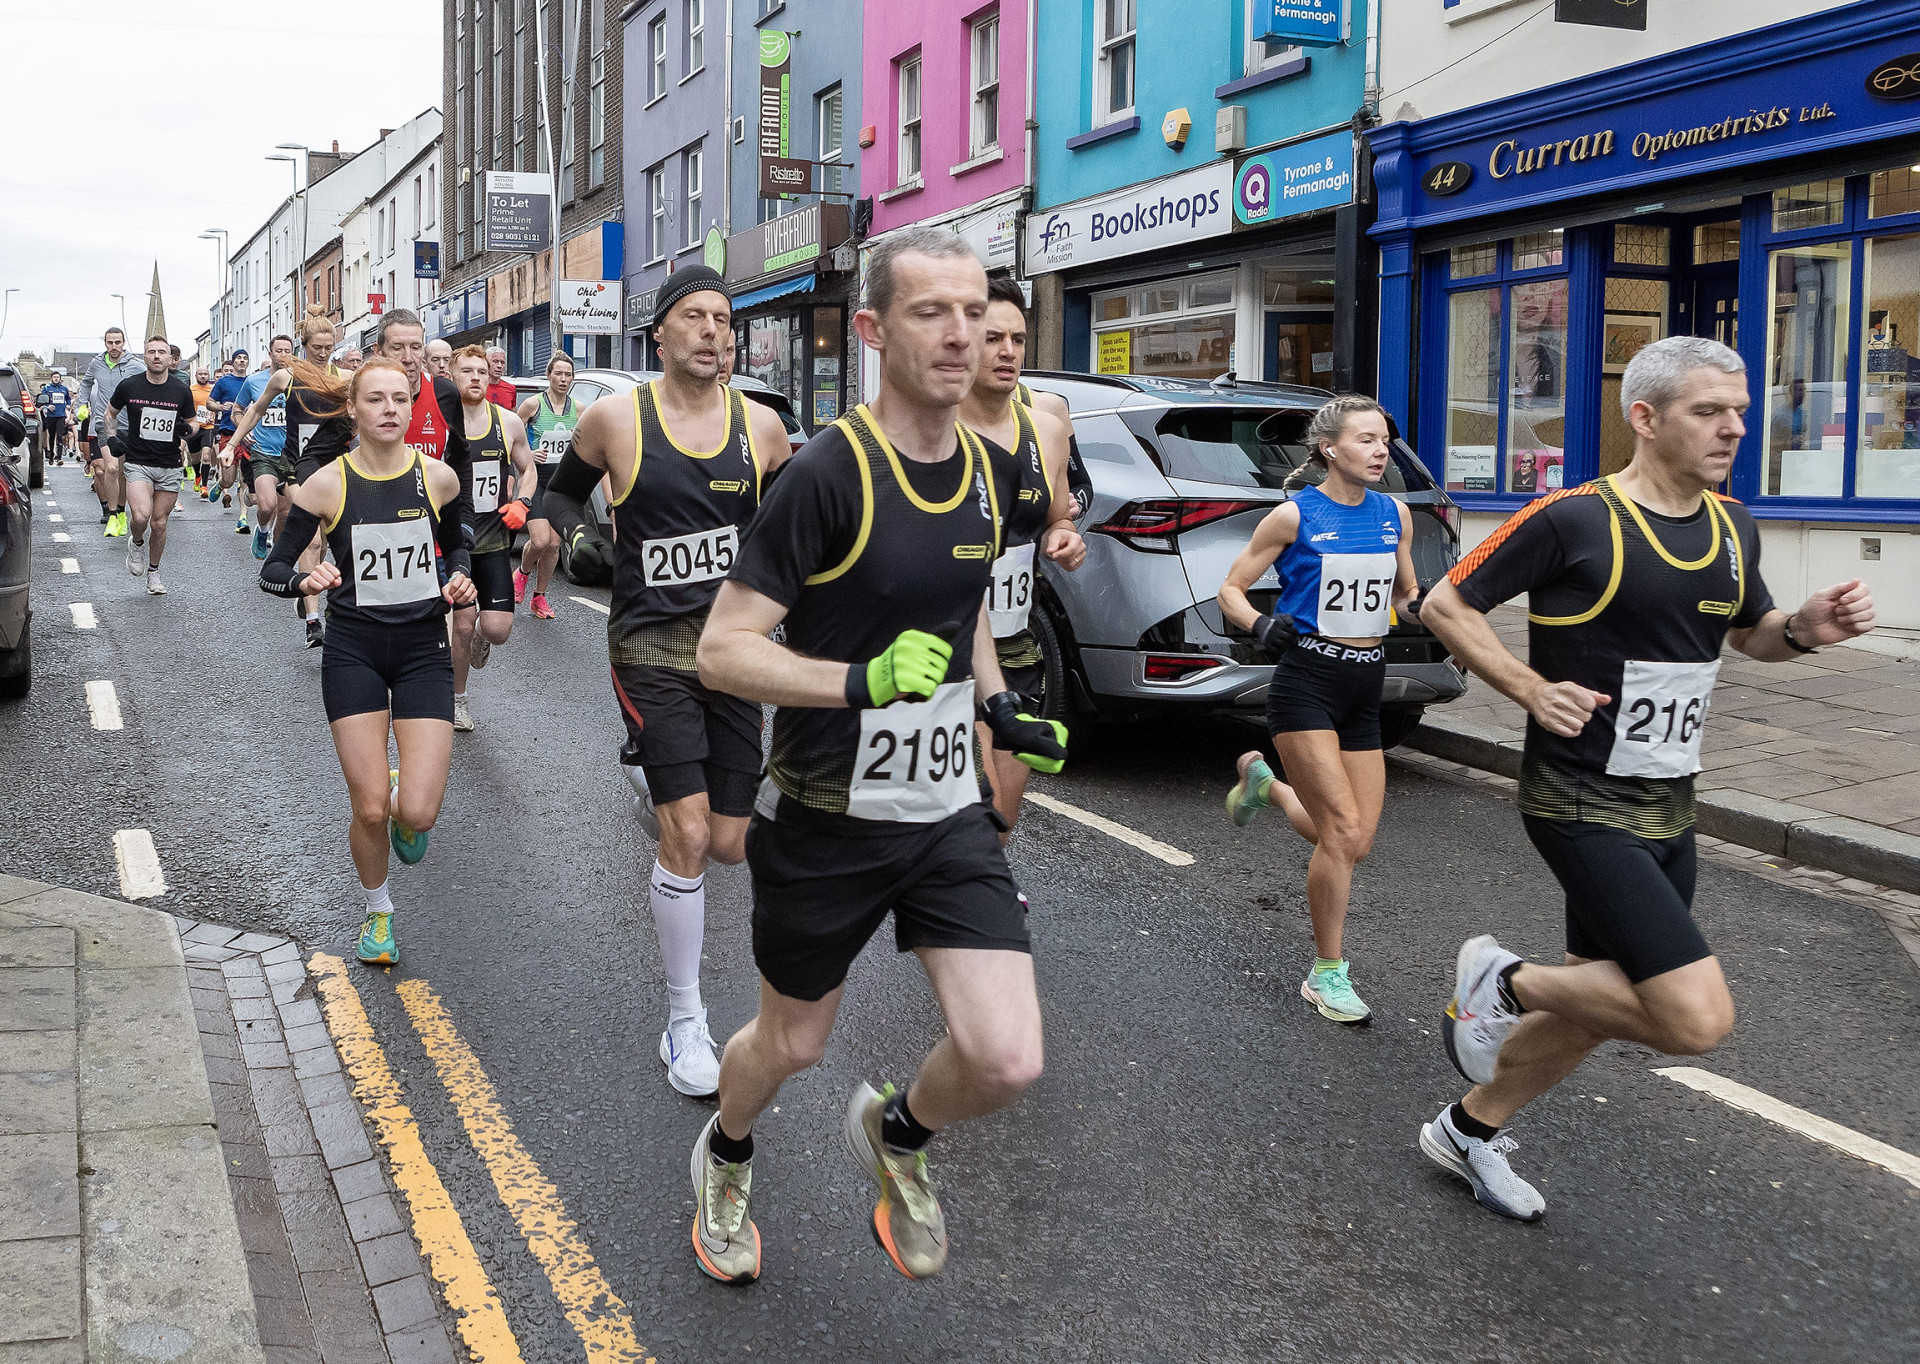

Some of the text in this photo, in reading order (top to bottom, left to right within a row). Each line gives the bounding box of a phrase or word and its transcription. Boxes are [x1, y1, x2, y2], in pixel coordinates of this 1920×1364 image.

[1274, 5, 1336, 24] Fermanagh
[1489, 102, 1837, 179] Curran Optometrists Ltd.
[770, 165, 804, 181] Ristretto
[1284, 156, 1334, 183] Tyrone &
[1430, 165, 1456, 190] 44
[1246, 173, 1266, 204] Q
[1283, 171, 1350, 200] Fermanagh
[491, 196, 529, 208] To Let
[492, 207, 515, 215] Prime
[1247, 205, 1269, 220] Radio
[492, 215, 532, 224] Retail Unit
[1091, 189, 1220, 242] Bookshops
[765, 206, 817, 258] RIVERFRONT
[765, 245, 818, 270] COFFEE HOUSE
[1046, 252, 1073, 265] Mission
[1056, 242, 1073, 254] Faith
[577, 286, 598, 297] Chic
[583, 298, 591, 307] &
[589, 307, 618, 320] Living
[1101, 365, 1109, 373] and
[142, 417, 173, 432] 2138
[738, 433, 749, 465] 2XU
[1029, 441, 1040, 473] 2XU
[415, 468, 424, 497] 2XU
[359, 542, 432, 581] 2174
[649, 533, 734, 582] 2045
[1325, 578, 1392, 612] 2157
[1341, 648, 1381, 663] PRO
[862, 722, 968, 783] 2196
